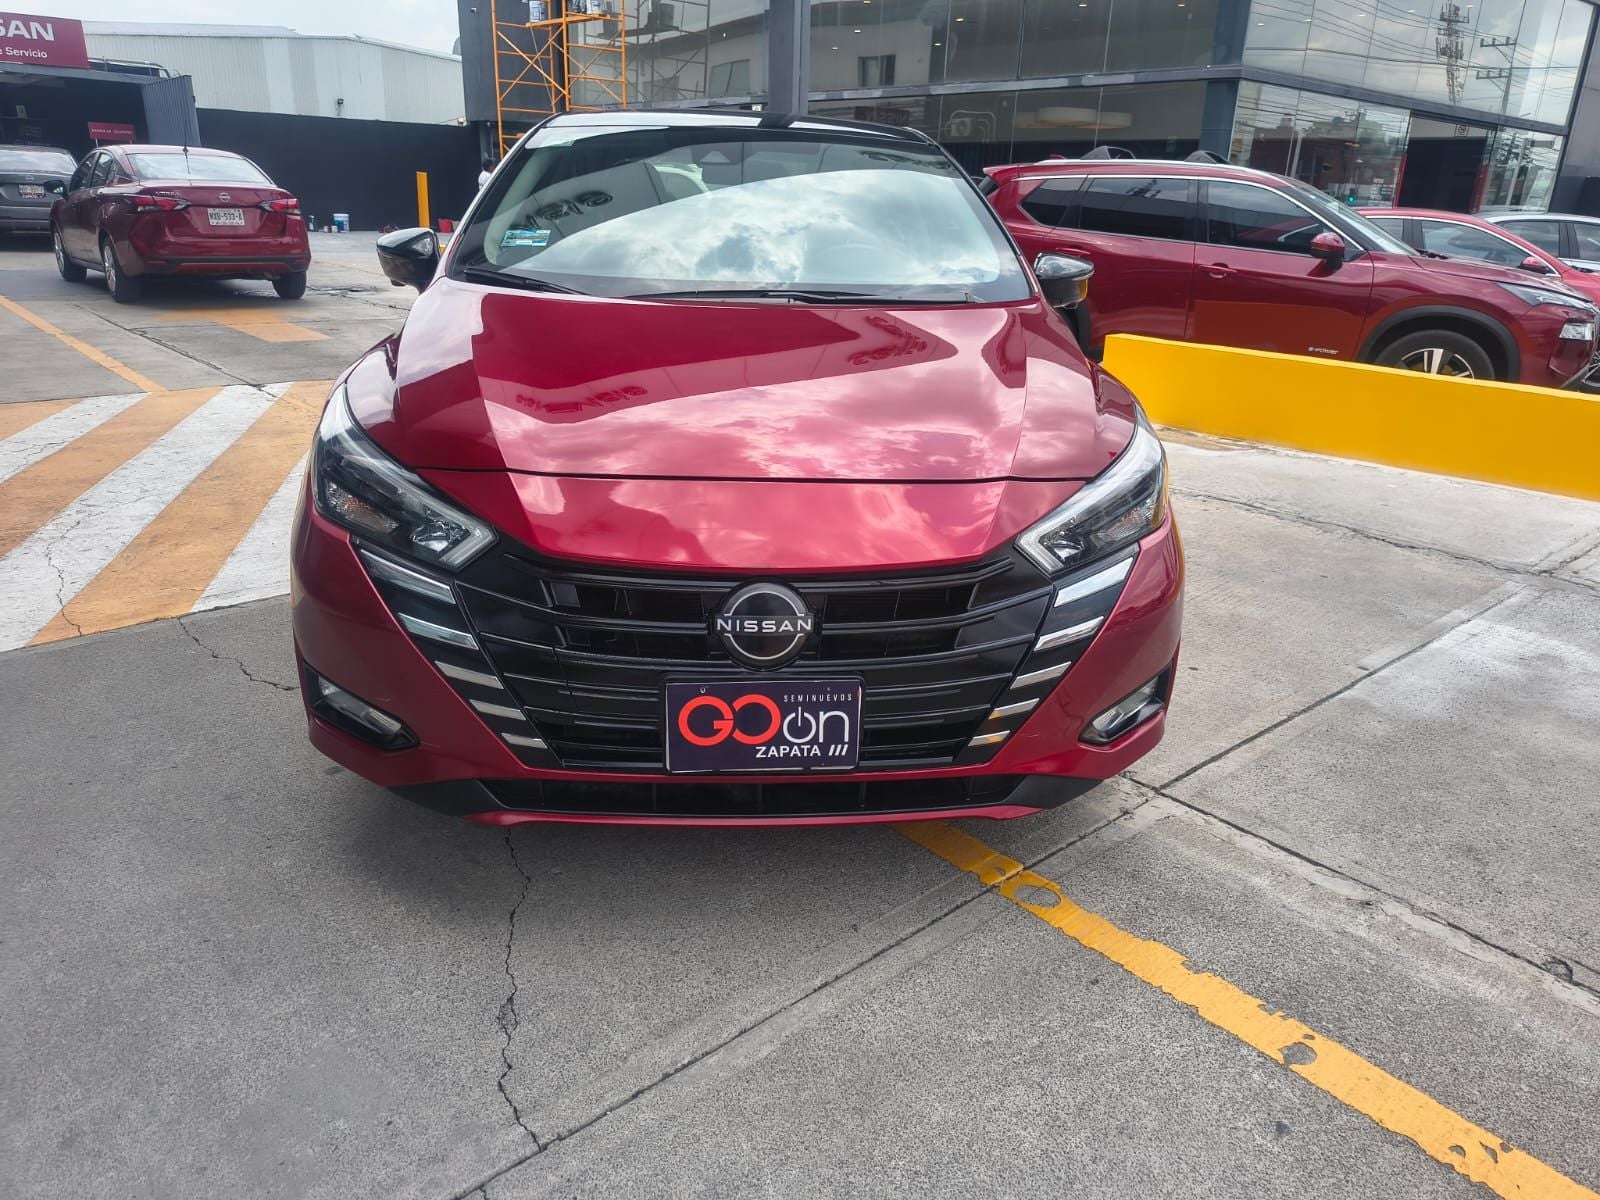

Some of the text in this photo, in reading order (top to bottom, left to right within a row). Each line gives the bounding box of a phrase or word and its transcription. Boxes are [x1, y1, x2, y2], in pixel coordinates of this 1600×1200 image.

[5, 46, 48, 58] Servicio
[716, 618, 812, 633] NISSAN
[783, 693, 852, 702] SEMINUEVOS
[755, 744, 821, 758] ZAPATA
